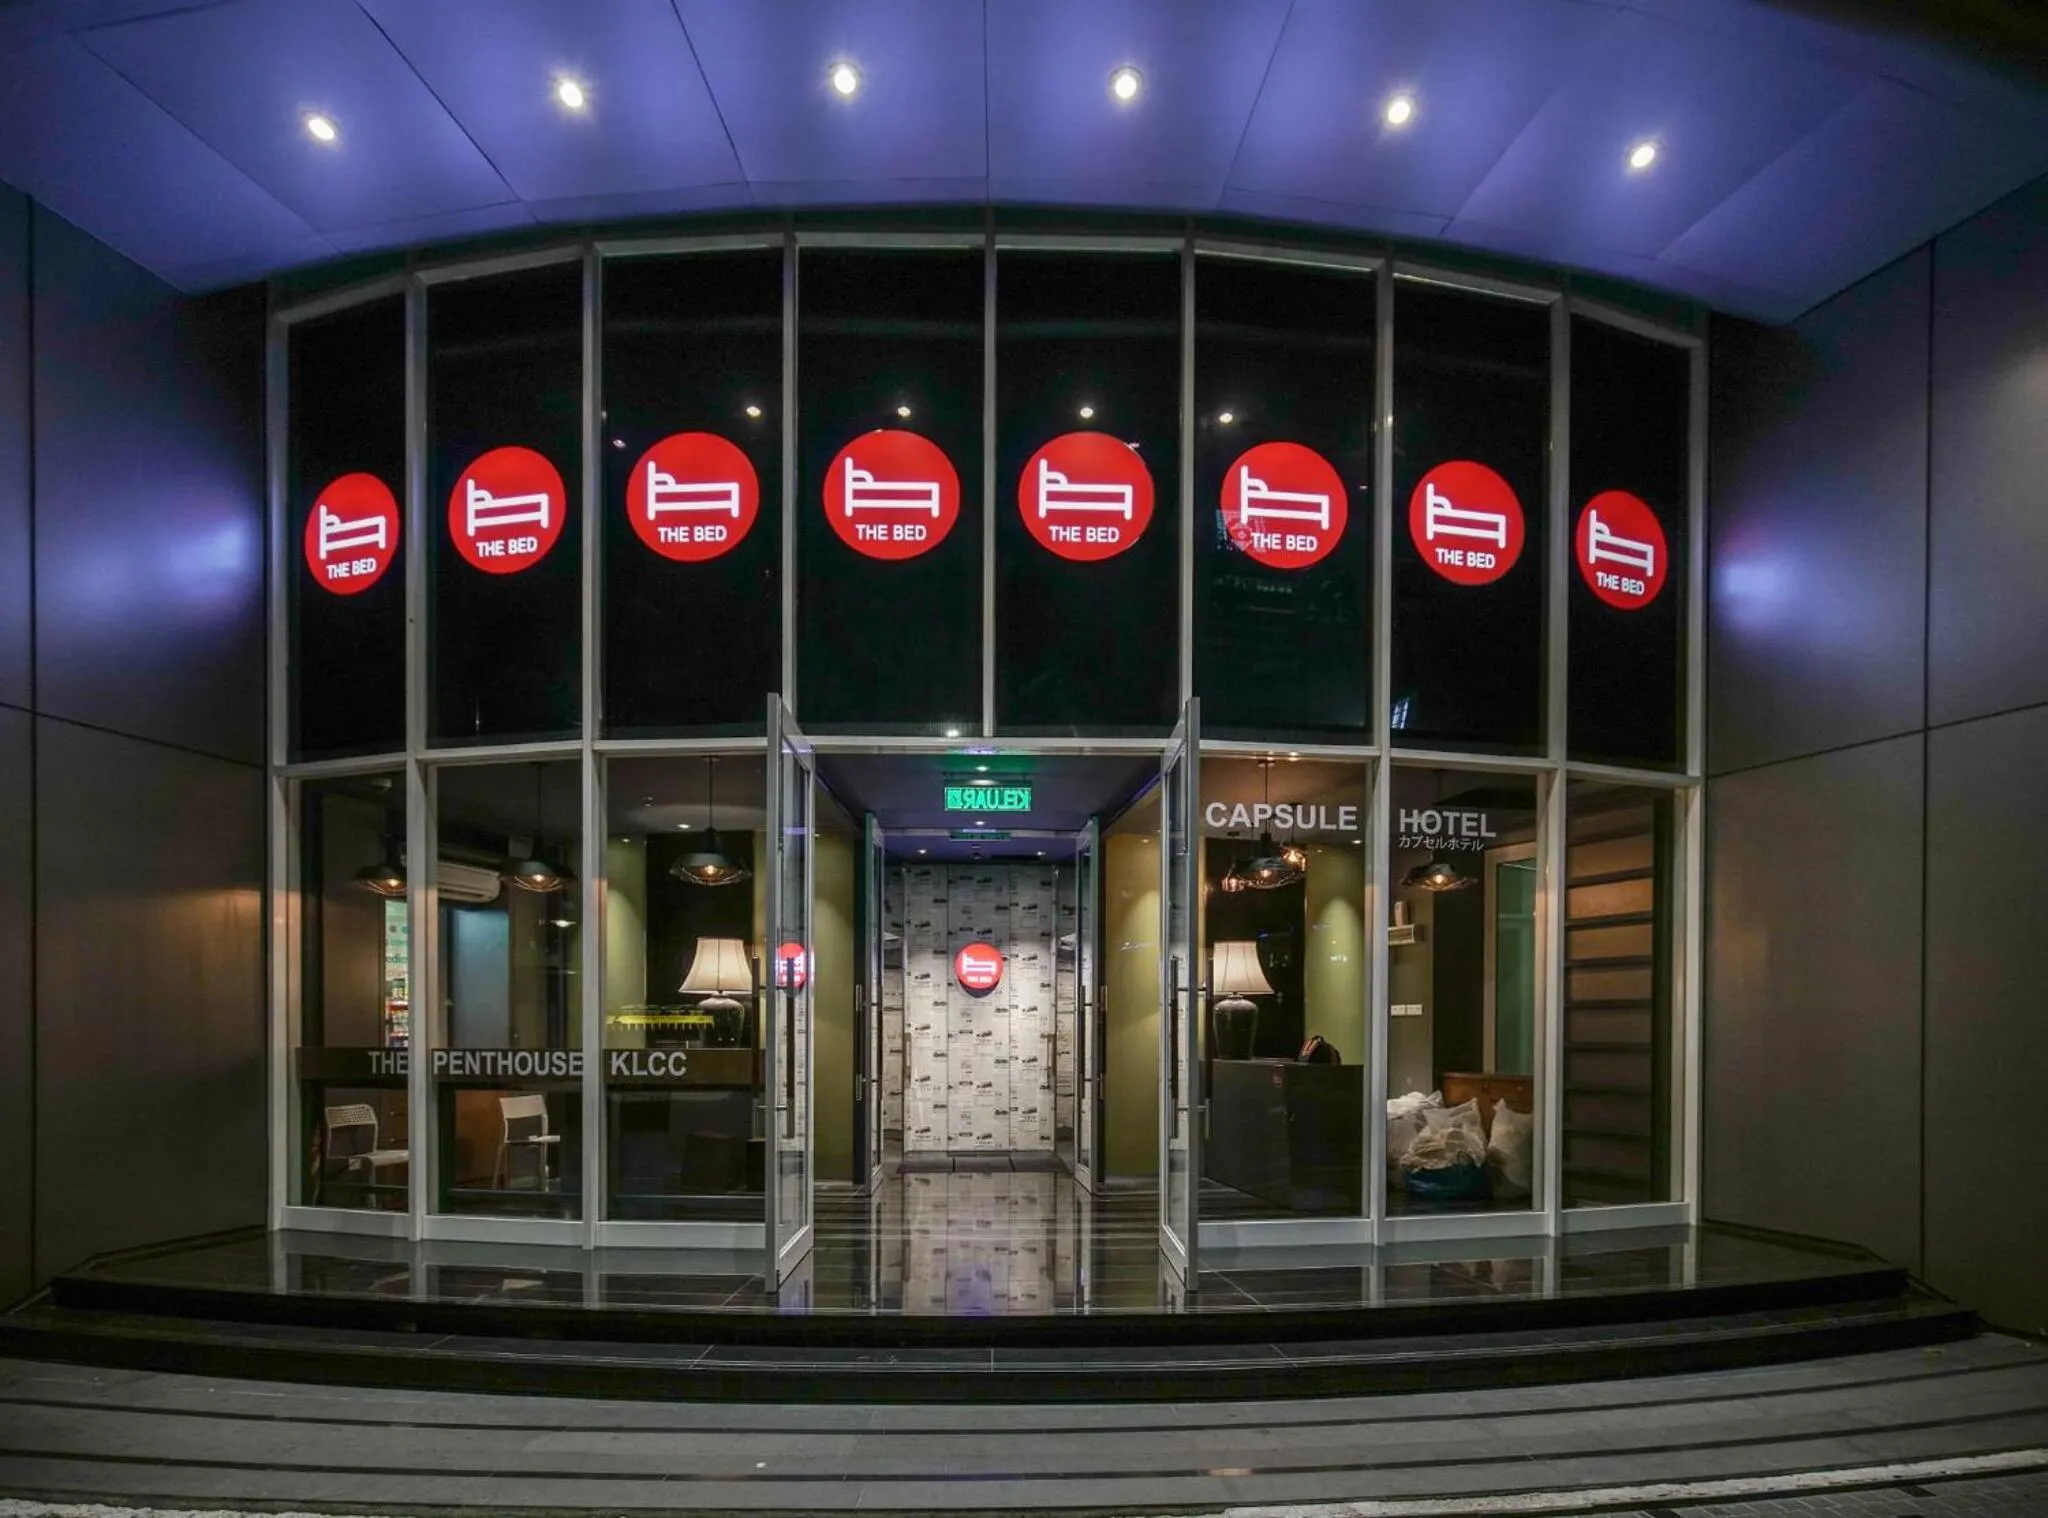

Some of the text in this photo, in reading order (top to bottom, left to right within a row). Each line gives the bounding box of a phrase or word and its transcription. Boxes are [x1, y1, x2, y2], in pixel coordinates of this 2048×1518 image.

[655, 525, 727, 543] THE BED
[855, 523, 927, 541] THE BED
[1048, 525, 1120, 543] THE BED
[1251, 532, 1317, 552] THE BED
[475, 536, 538, 557] THE BED
[326, 557, 377, 579] THE BED
[1435, 547, 1496, 569] THE BED
[1596, 571, 1645, 596] THE BED
[1205, 802, 1497, 838] CAPSULE HOTEL
[367, 1050, 687, 1076] THE PENTHOUSE KLCC
